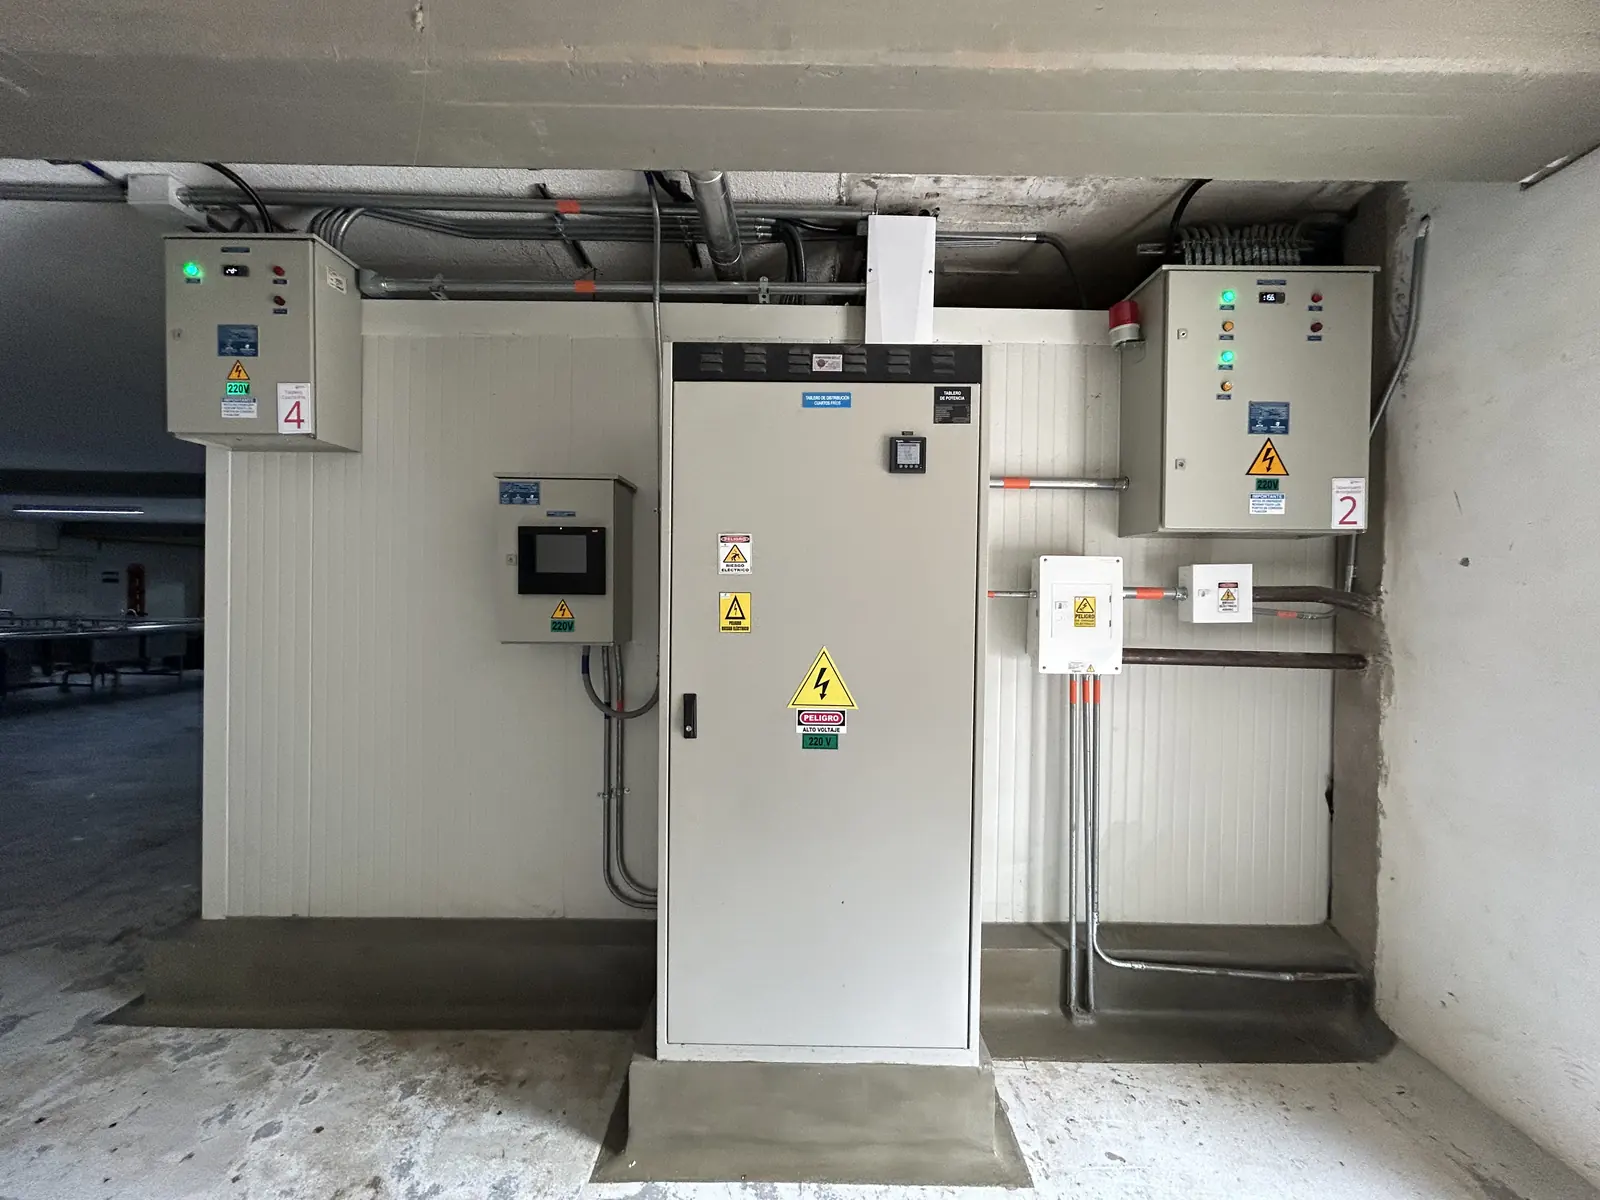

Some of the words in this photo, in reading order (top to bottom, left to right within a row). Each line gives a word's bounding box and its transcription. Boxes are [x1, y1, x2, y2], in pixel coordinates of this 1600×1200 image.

[228, 384, 250, 393] 220V
[284, 400, 305, 429] 4
[1257, 479, 1279, 489] 220V
[1339, 495, 1358, 525] 2
[551, 621, 575, 631] 220V
[803, 714, 840, 722] PELIGRO
[808, 736, 824, 746] 220
[825, 736, 832, 746] V
